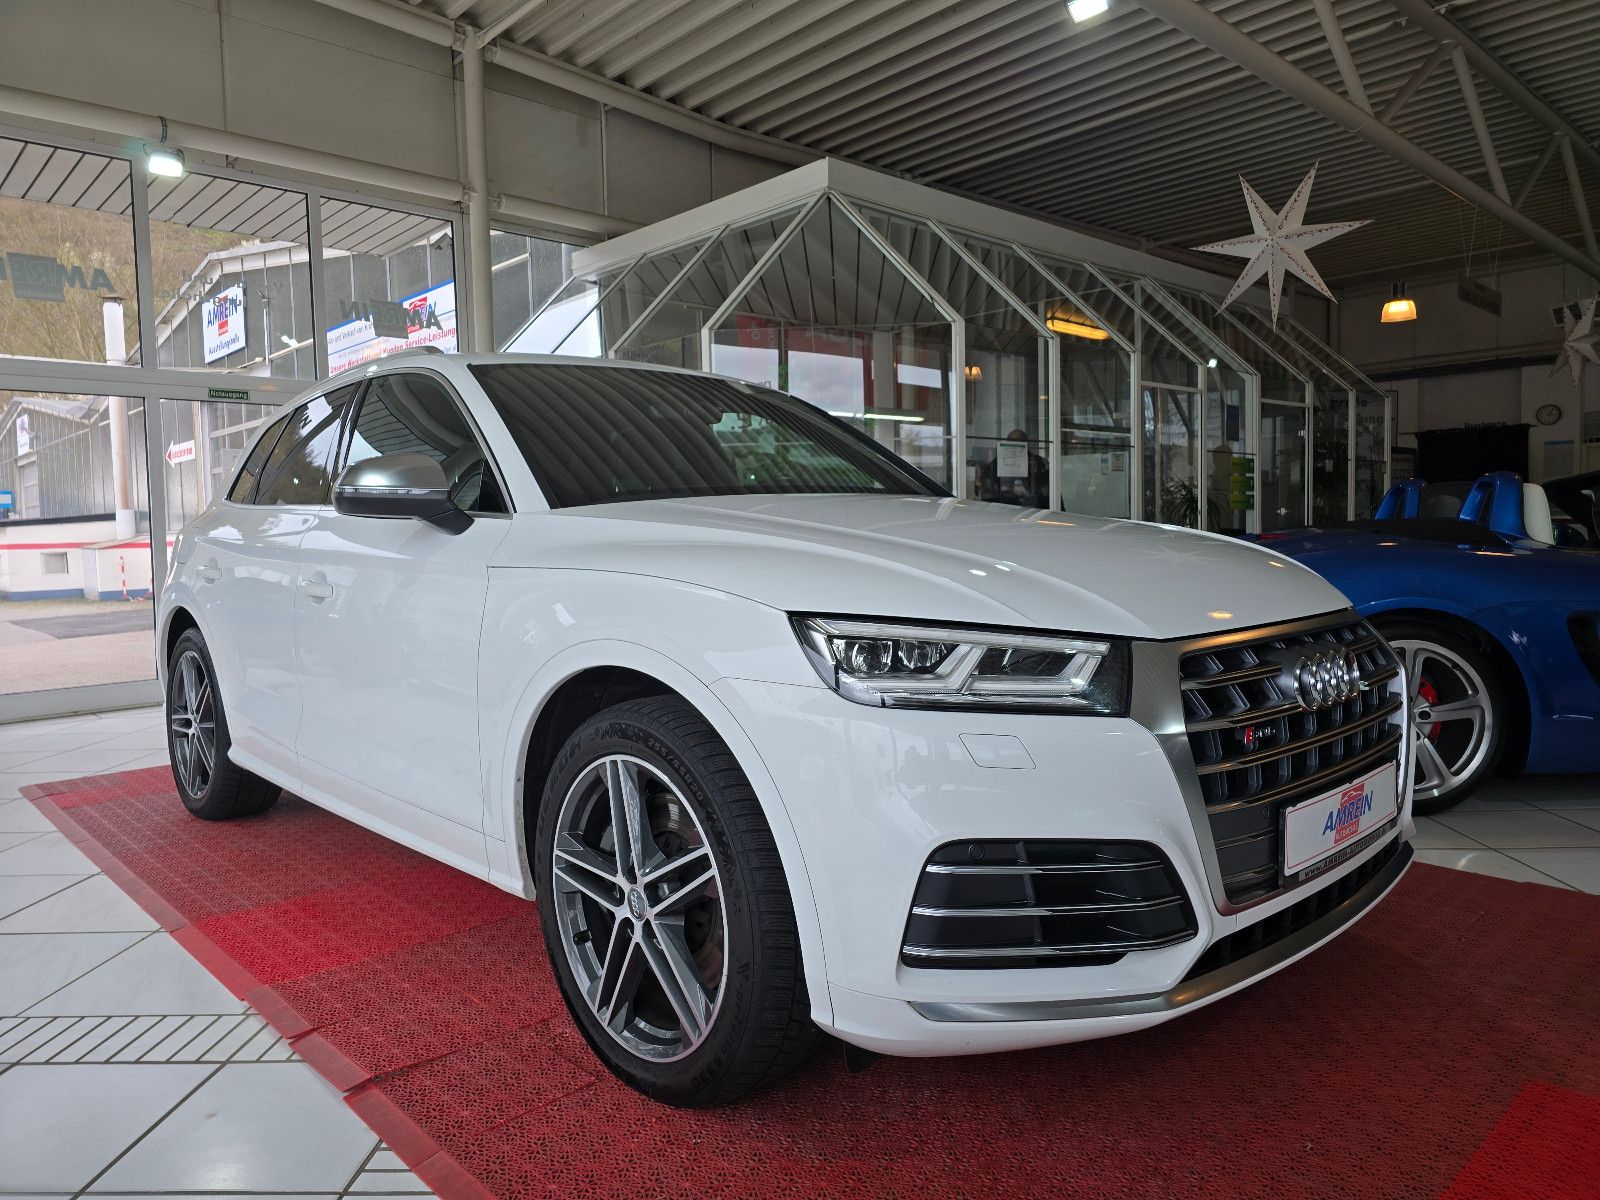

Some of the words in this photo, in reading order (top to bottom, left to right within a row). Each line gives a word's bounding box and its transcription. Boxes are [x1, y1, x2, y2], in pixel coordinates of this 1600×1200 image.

[210, 389, 248, 400] Notausgang
[647, 737, 705, 801] 255/45R20
[1323, 791, 1373, 835] AMREIN
